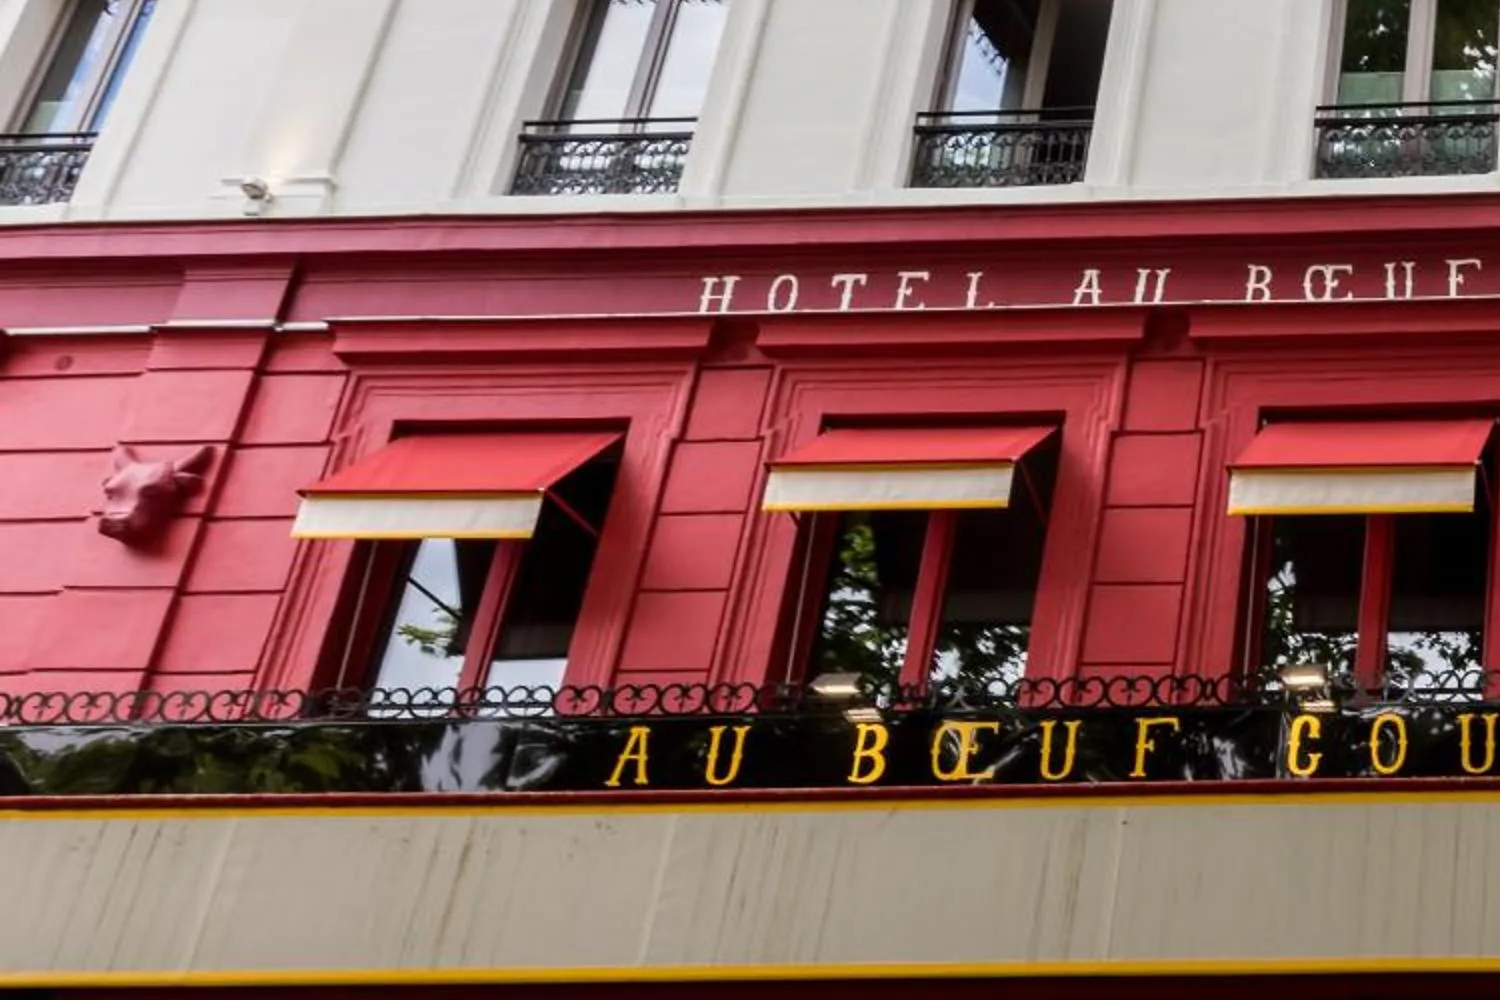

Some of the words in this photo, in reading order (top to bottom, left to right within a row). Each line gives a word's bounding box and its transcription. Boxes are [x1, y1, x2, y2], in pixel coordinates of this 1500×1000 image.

[697, 270, 993, 313] HOTEL
[1072, 266, 1171, 307] AU
[604, 726, 752, 786] AU
[847, 717, 1180, 783] BŒUF
